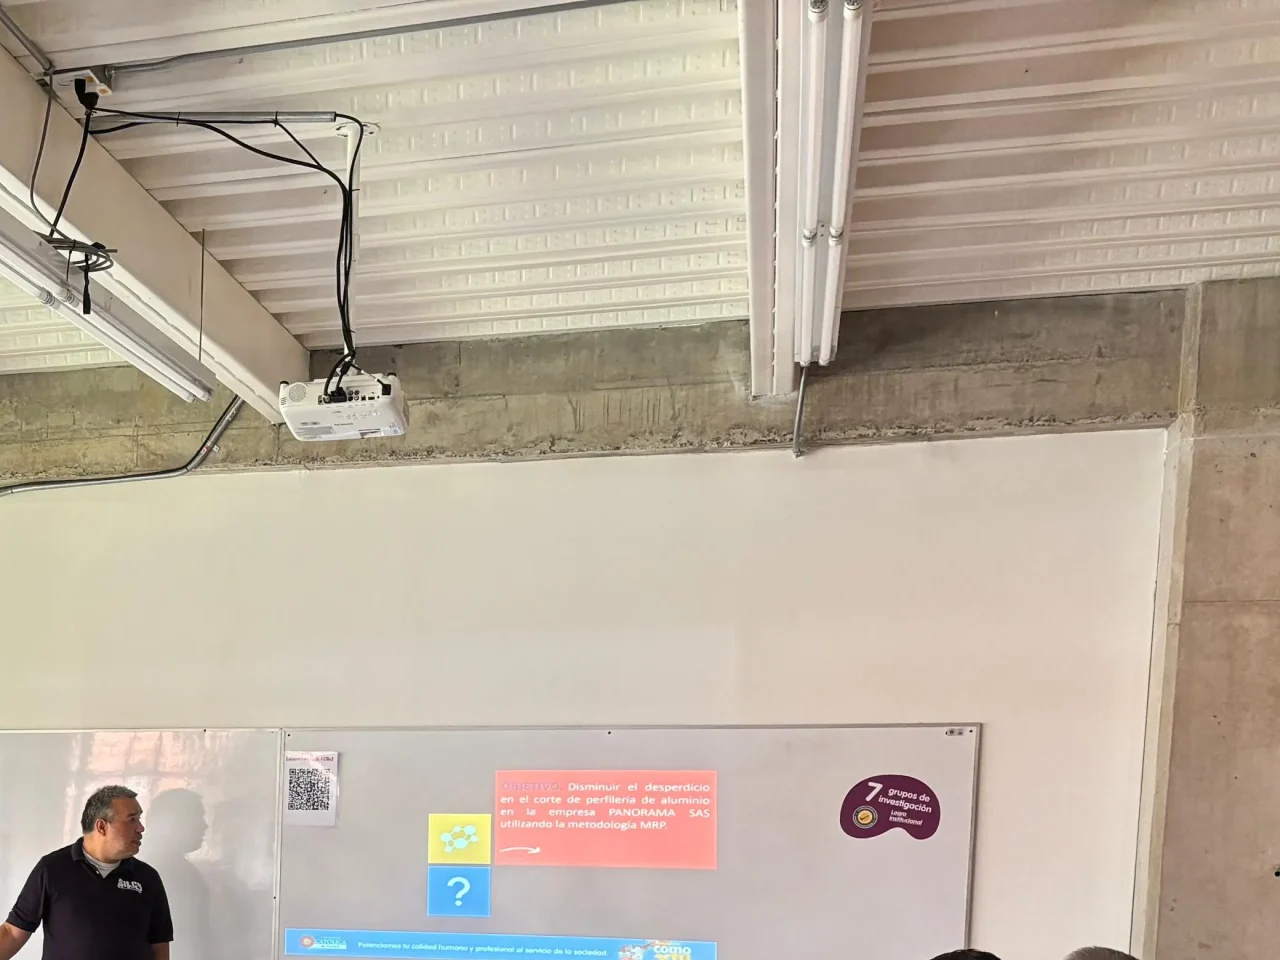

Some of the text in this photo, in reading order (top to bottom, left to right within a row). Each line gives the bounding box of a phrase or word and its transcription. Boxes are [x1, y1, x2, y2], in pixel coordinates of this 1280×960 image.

[569, 782, 620, 791] Disminuir
[628, 782, 637, 791] el
[645, 782, 710, 793] desperdicio
[865, 782, 883, 802] 7
[519, 795, 528, 803] el
[642, 796, 655, 804] de
[661, 796, 710, 805] aluminio
[888, 788, 930, 802] grupos de
[878, 795, 932, 813] investigación
[527, 808, 535, 816] la
[549, 809, 595, 818] empresa
[609, 809, 675, 817] PANORAMA
[689, 809, 710, 817] SAS
[500, 820, 552, 828] utilizando
[555, 820, 564, 828] la
[568, 821, 637, 830] metodología
